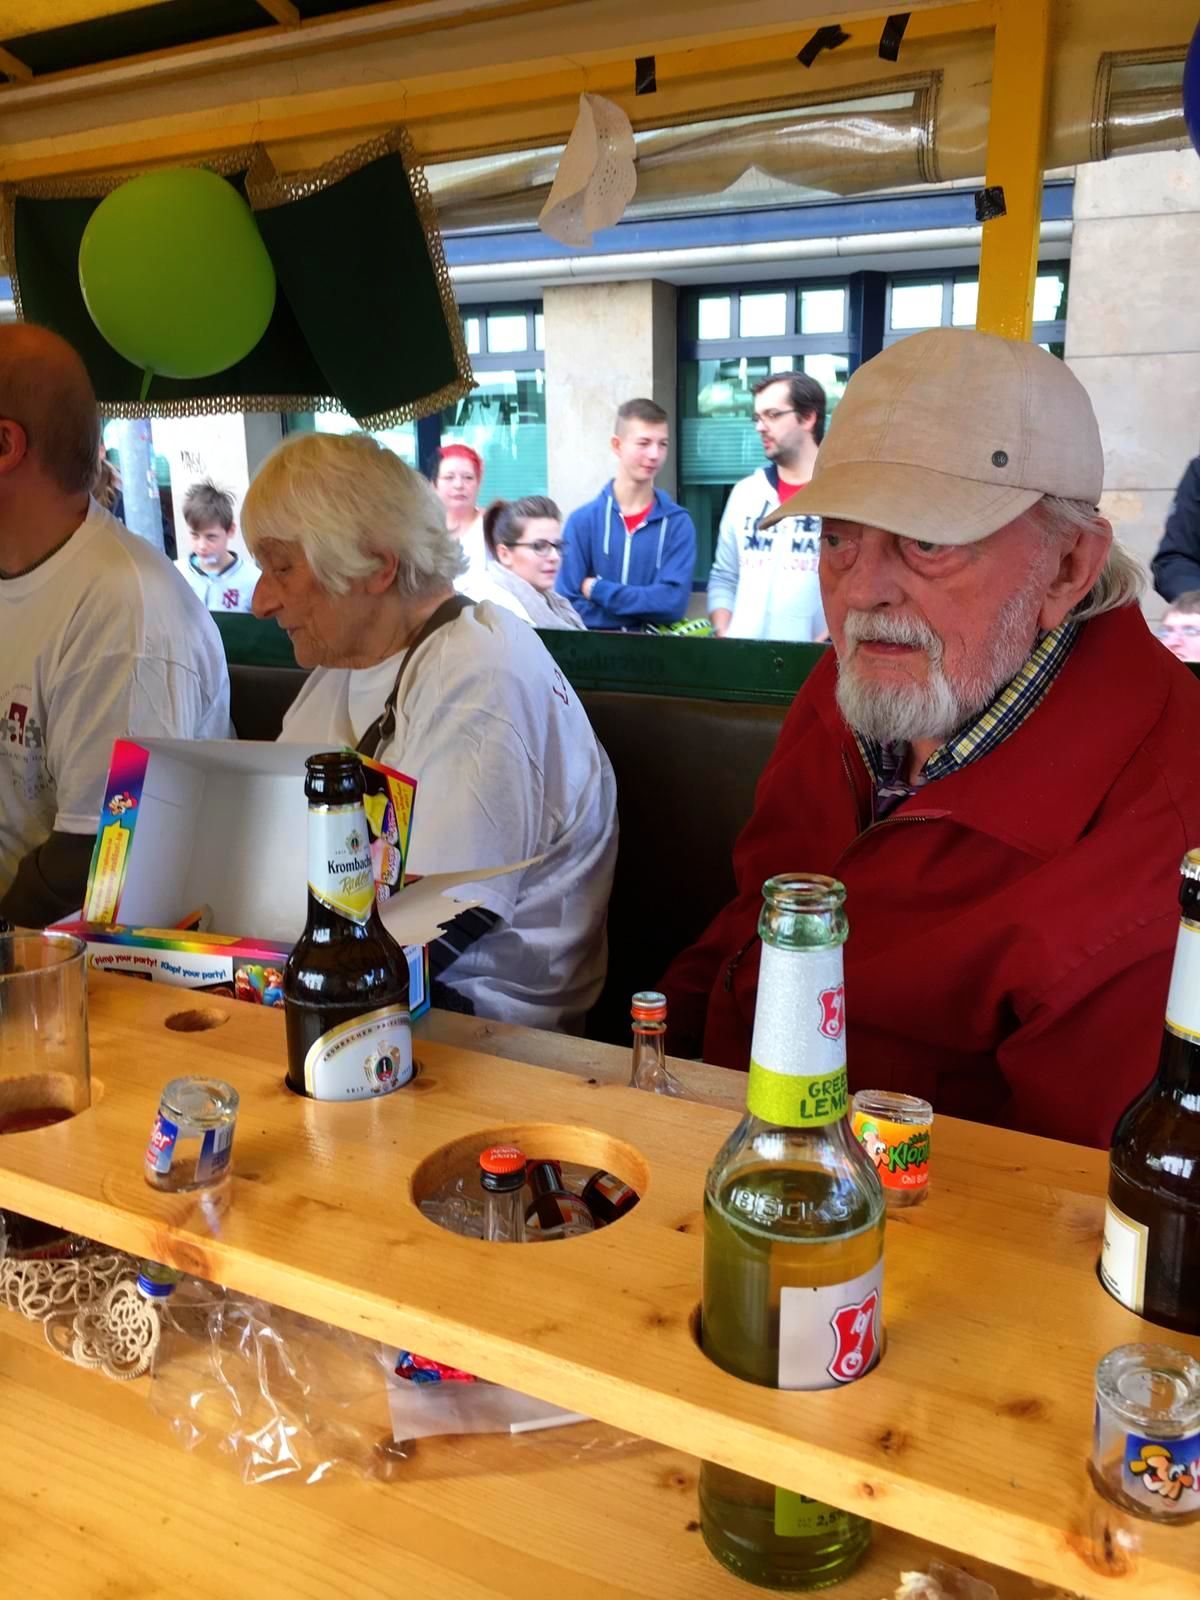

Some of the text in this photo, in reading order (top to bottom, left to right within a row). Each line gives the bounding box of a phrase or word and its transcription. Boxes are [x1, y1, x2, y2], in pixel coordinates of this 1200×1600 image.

[115, 954, 132, 964] your
[134, 954, 158, 968] party!
[182, 968, 201, 978] your
[201, 969, 227, 981] party!
